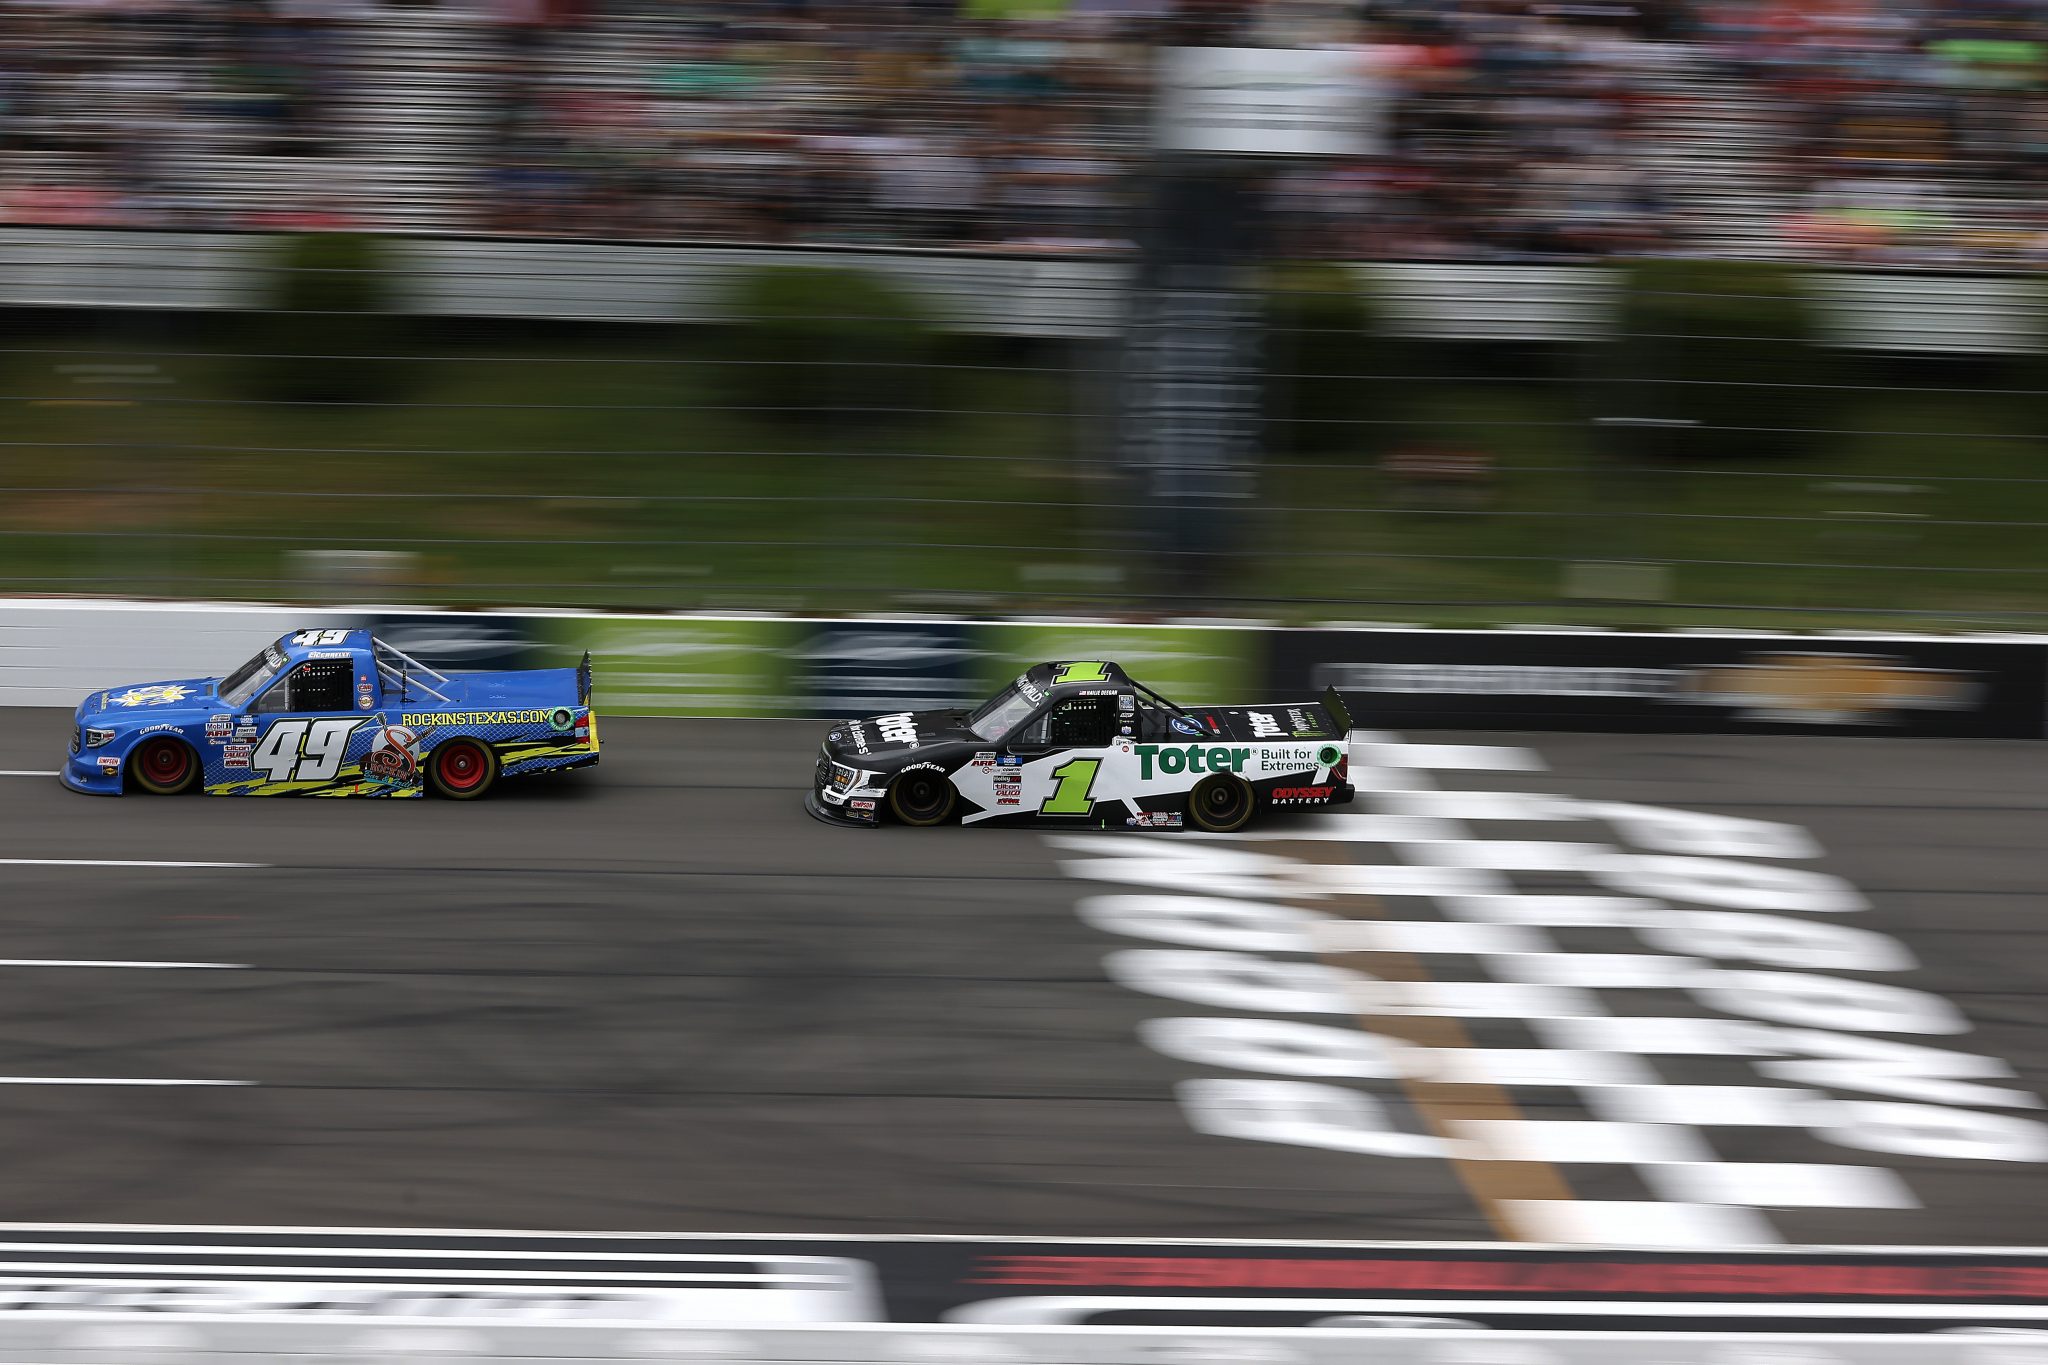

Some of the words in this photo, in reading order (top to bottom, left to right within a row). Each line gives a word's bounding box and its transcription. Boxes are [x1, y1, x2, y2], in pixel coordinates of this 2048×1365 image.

[291, 629, 350, 647] 49
[1051, 661, 1111, 687] 1
[401, 710, 551, 726] ROCKINSTEXAS.COM
[139, 723, 185, 736] GOODYEAR
[252, 718, 368, 781] 49
[1261, 748, 1290, 759] Built
[1294, 748, 1312, 759] for
[98, 757, 119, 766] SIMPSON
[900, 762, 945, 774] GOODYEAR
[1134, 745, 1250, 780] Toter
[1039, 758, 1102, 816] 1
[1272, 787, 1334, 798] ODYSSEY
[852, 801, 874, 809] SIMPSON
[1271, 797, 1330, 805] BATTERY
